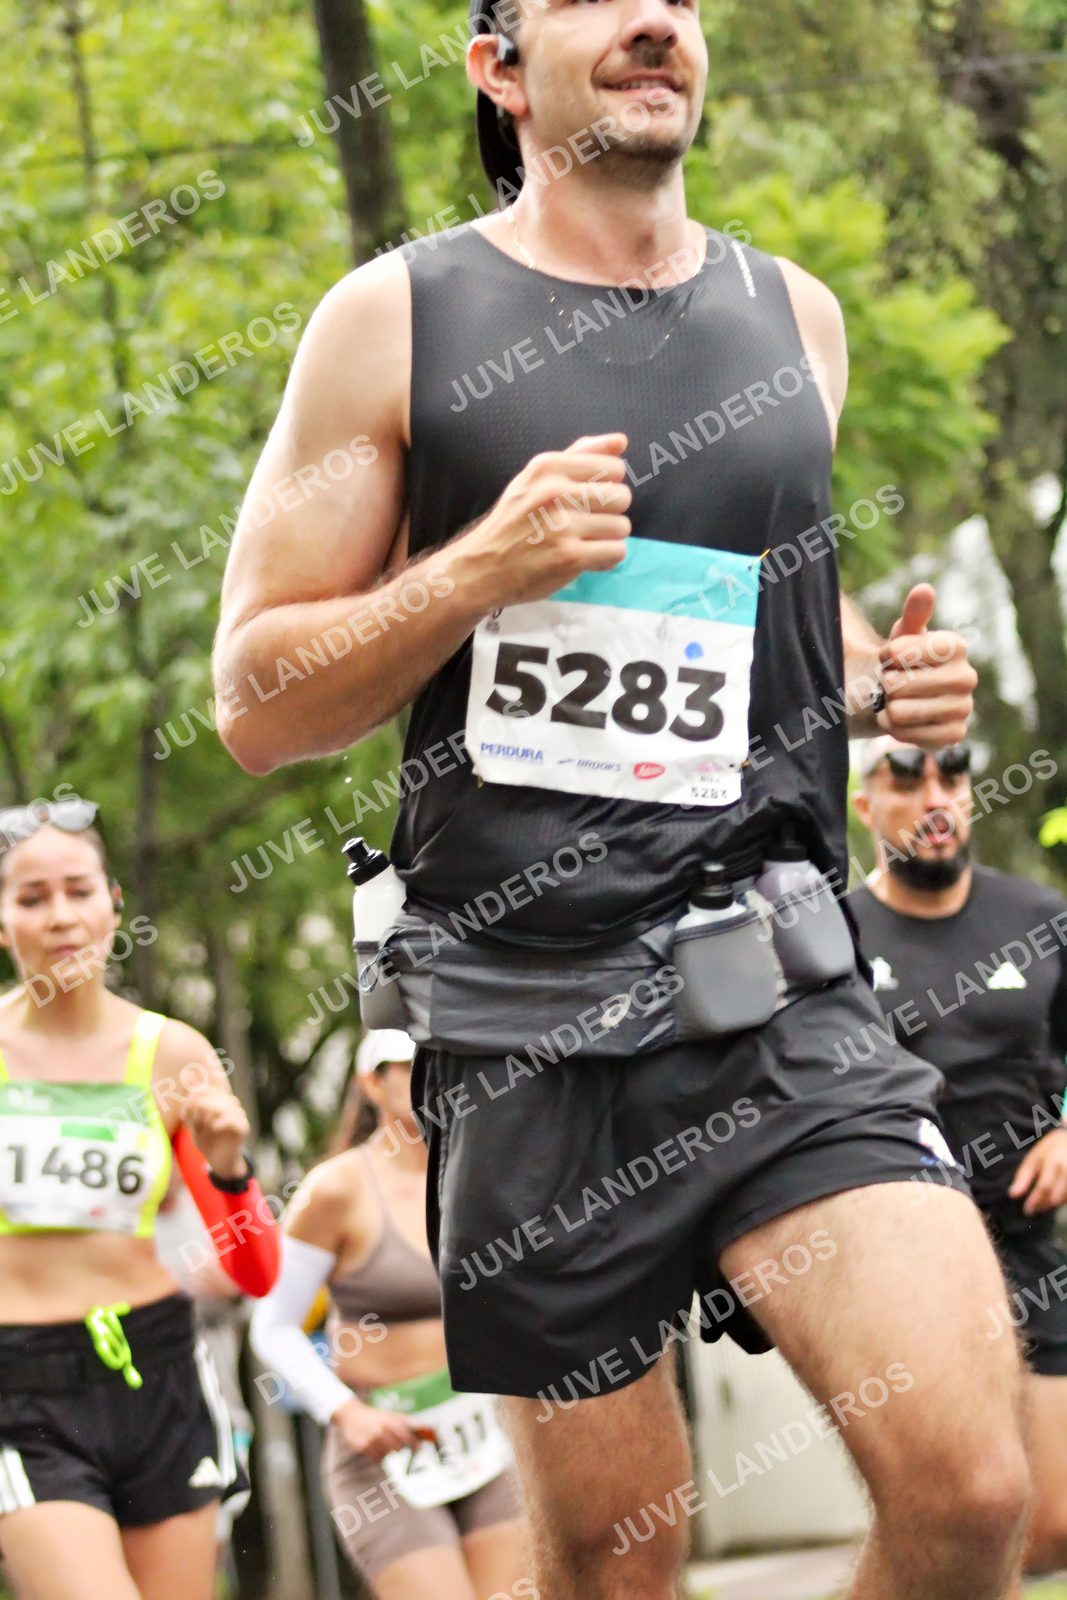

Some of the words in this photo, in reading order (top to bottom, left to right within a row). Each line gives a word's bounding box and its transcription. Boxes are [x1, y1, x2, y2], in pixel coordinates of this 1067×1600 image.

[486, 642, 726, 742] 5283
[480, 743, 544, 760] PERDURA
[577, 759, 622, 772] BROOKS
[8, 1145, 144, 1195] 1486
